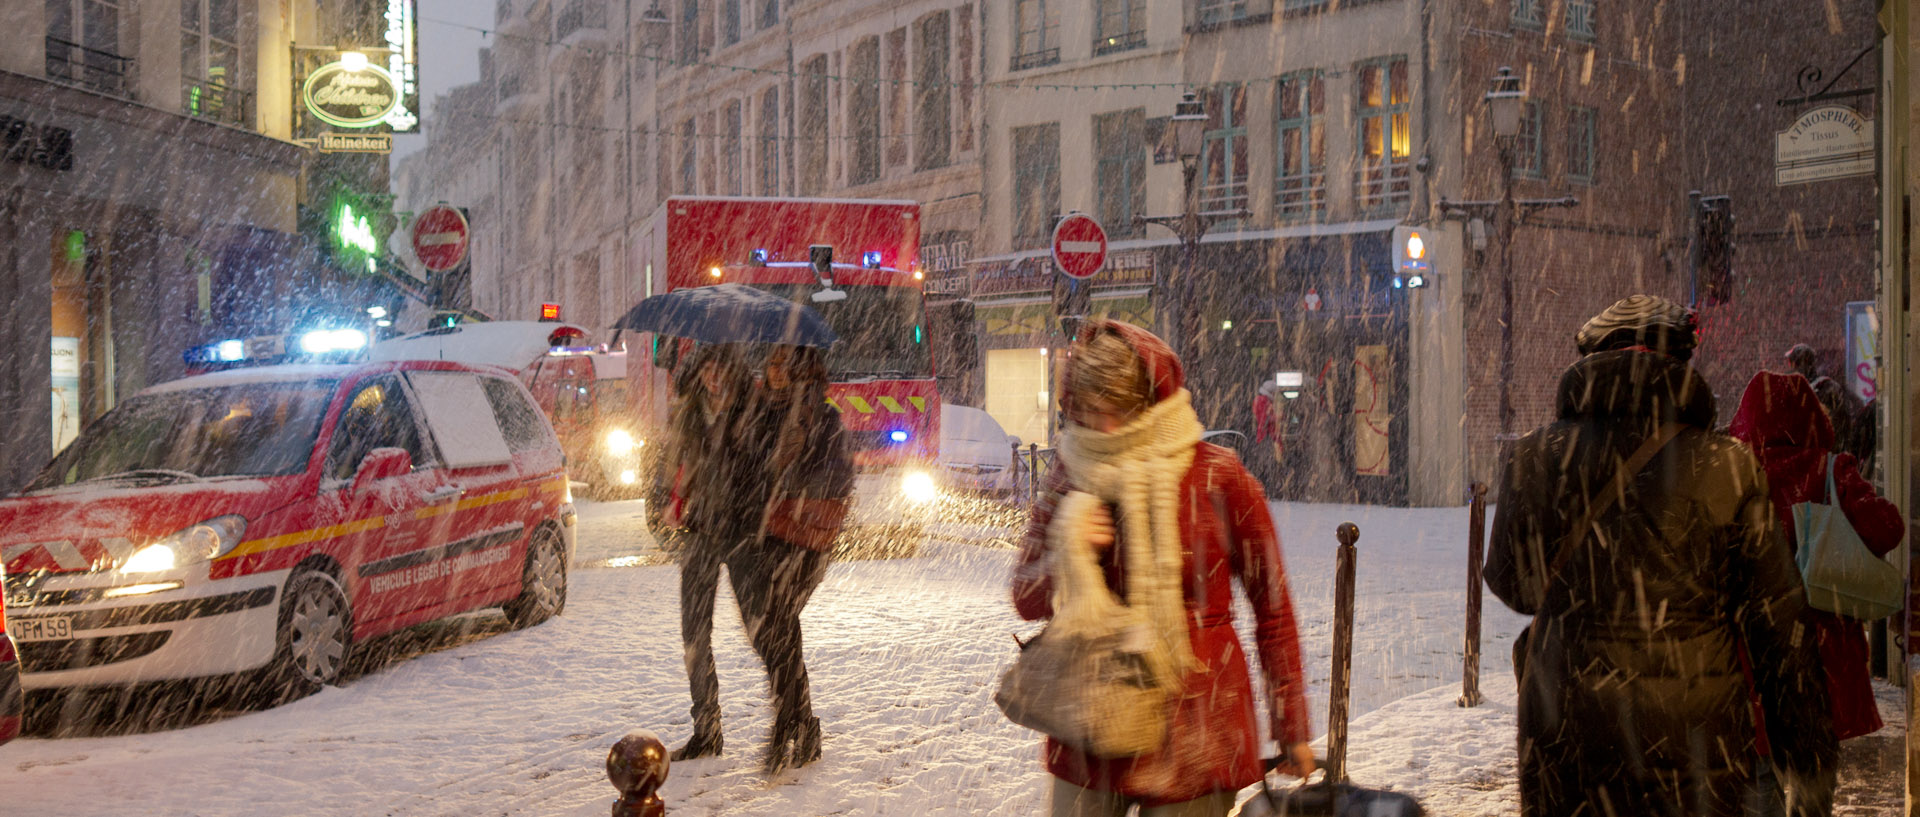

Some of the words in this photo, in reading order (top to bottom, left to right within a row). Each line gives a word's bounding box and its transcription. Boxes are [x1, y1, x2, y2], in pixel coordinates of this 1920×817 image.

[1789, 110, 1864, 144] ATMOSPHERE
[1811, 131, 1839, 141] Tissus
[323, 136, 388, 149] Heineken
[921, 241, 969, 272] TIME
[923, 277, 968, 292] CONCEPT
[369, 569, 412, 595] VEHICULE
[440, 560, 451, 577] DE
[452, 545, 511, 572] COMMANDEMENT
[47, 619, 68, 638] 59
